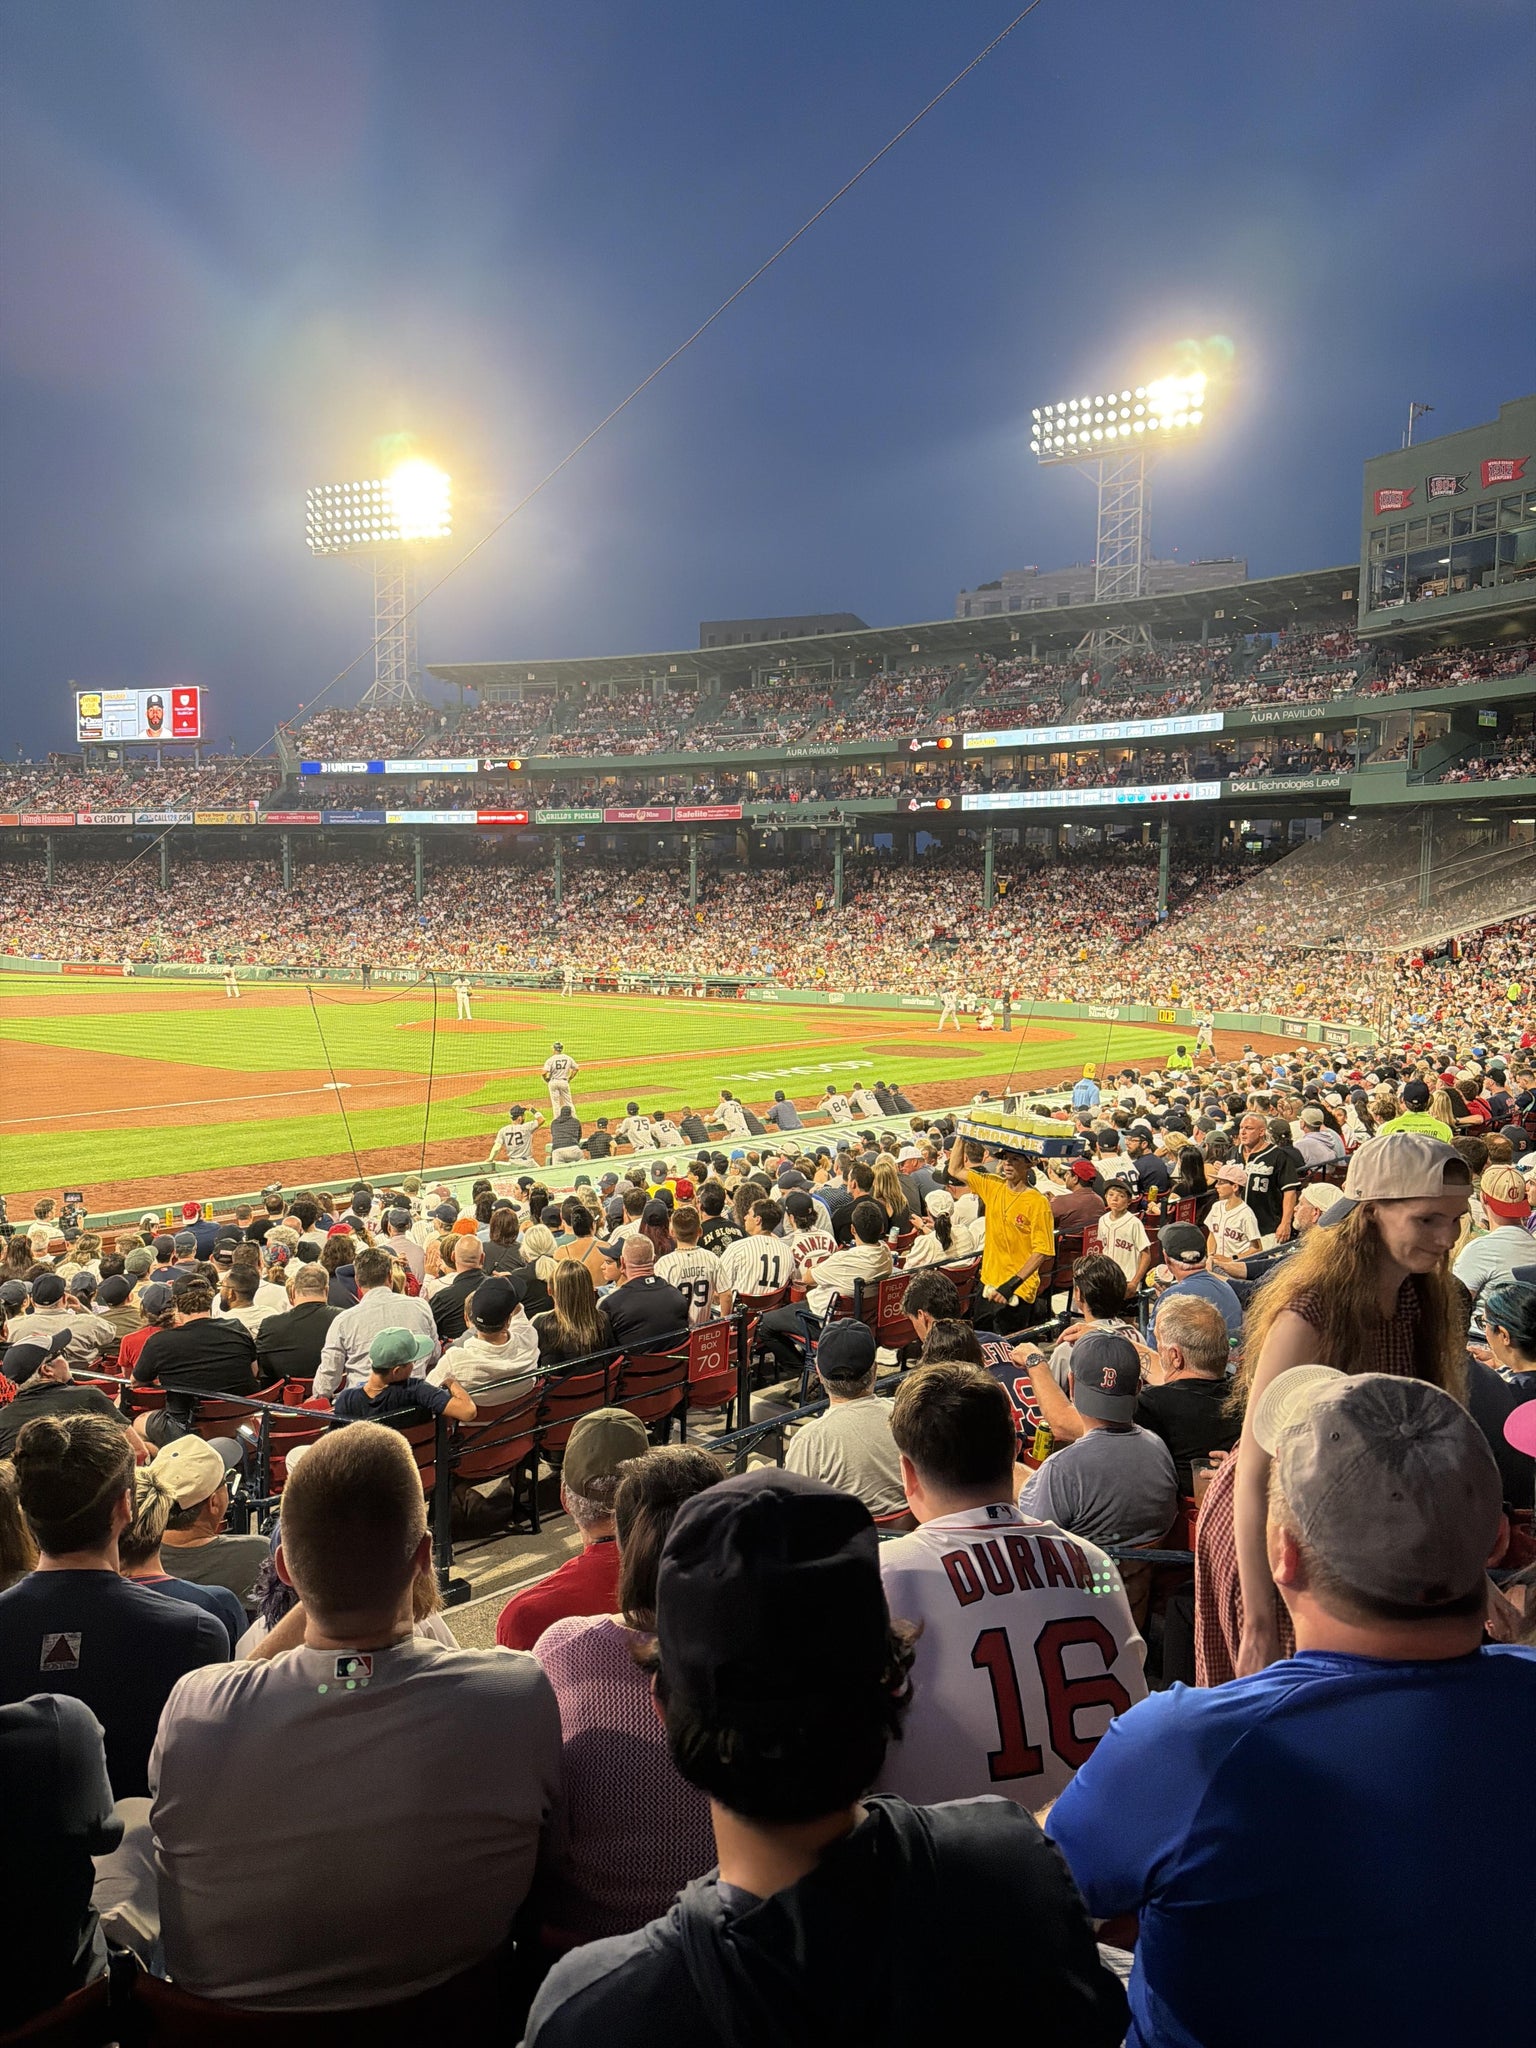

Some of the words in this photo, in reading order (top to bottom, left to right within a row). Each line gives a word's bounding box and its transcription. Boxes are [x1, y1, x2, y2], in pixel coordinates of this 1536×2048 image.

[1489, 464, 1513, 476] 1912
[1283, 707, 1325, 719] PAVILION
[809, 746, 838, 756] PAVILION
[1258, 779, 1314, 790] Technologies
[1316, 777, 1340, 788] Level
[42, 815, 73, 823] Hawaiian
[618, 811, 636, 819] Ninety
[676, 809, 708, 819] Safelite
[555, 1059, 568, 1070] 67
[832, 1098, 848, 1113] 84
[633, 1119, 650, 1131] 75
[505, 1131, 524, 1146] 72
[962, 1123, 1041, 1151] LEMONADE
[1252, 1176, 1269, 1193] 13
[703, 1231, 714, 1246] IN
[1224, 1227, 1244, 1242] SOX
[793, 1235, 837, 1265] ENINTEN
[1115, 1238, 1134, 1252] SOX
[681, 1265, 706, 1279] JUDGE
[759, 1253, 780, 1288] 11
[677, 1280, 709, 1307] 99
[886, 1282, 904, 1292] FIELD
[887, 1292, 900, 1301] BOX
[883, 1302, 901, 1318] 69
[698, 1330, 721, 1342] FIELD
[701, 1341, 718, 1351] BOX
[697, 1352, 720, 1373] 70
[1100, 1366, 1117, 1389] B
[940, 1535, 1097, 1607] DURAN
[971, 1616, 1132, 1782] 16
